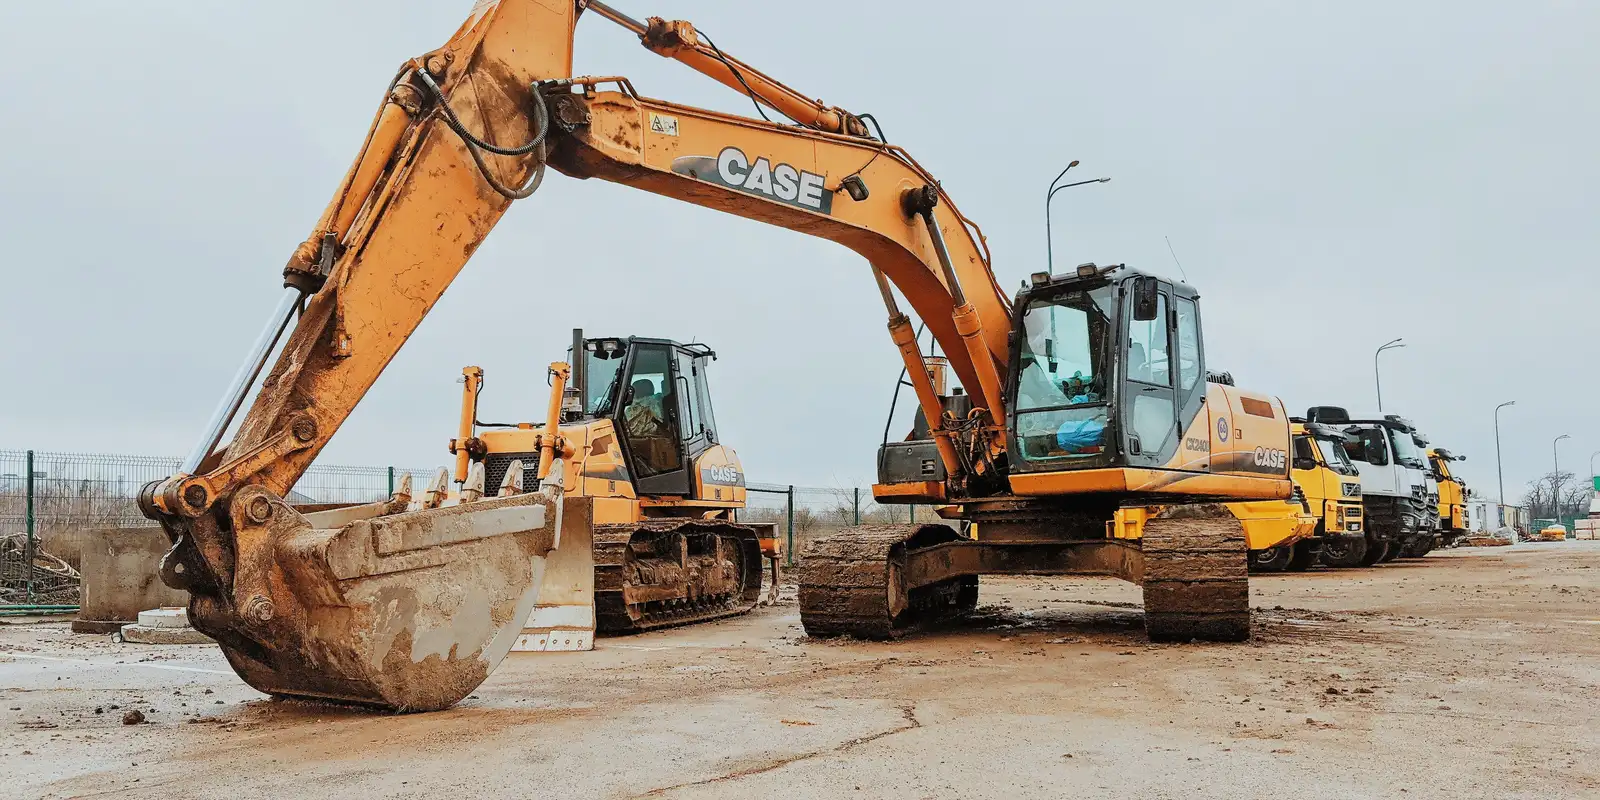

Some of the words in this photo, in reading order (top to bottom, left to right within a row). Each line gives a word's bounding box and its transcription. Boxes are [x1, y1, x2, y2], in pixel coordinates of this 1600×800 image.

[717, 146, 825, 208] CASE
[1052, 290, 1082, 301] CASE
[522, 461, 536, 470] ASE
[1254, 446, 1286, 469] CASE
[711, 464, 737, 482] CASE
